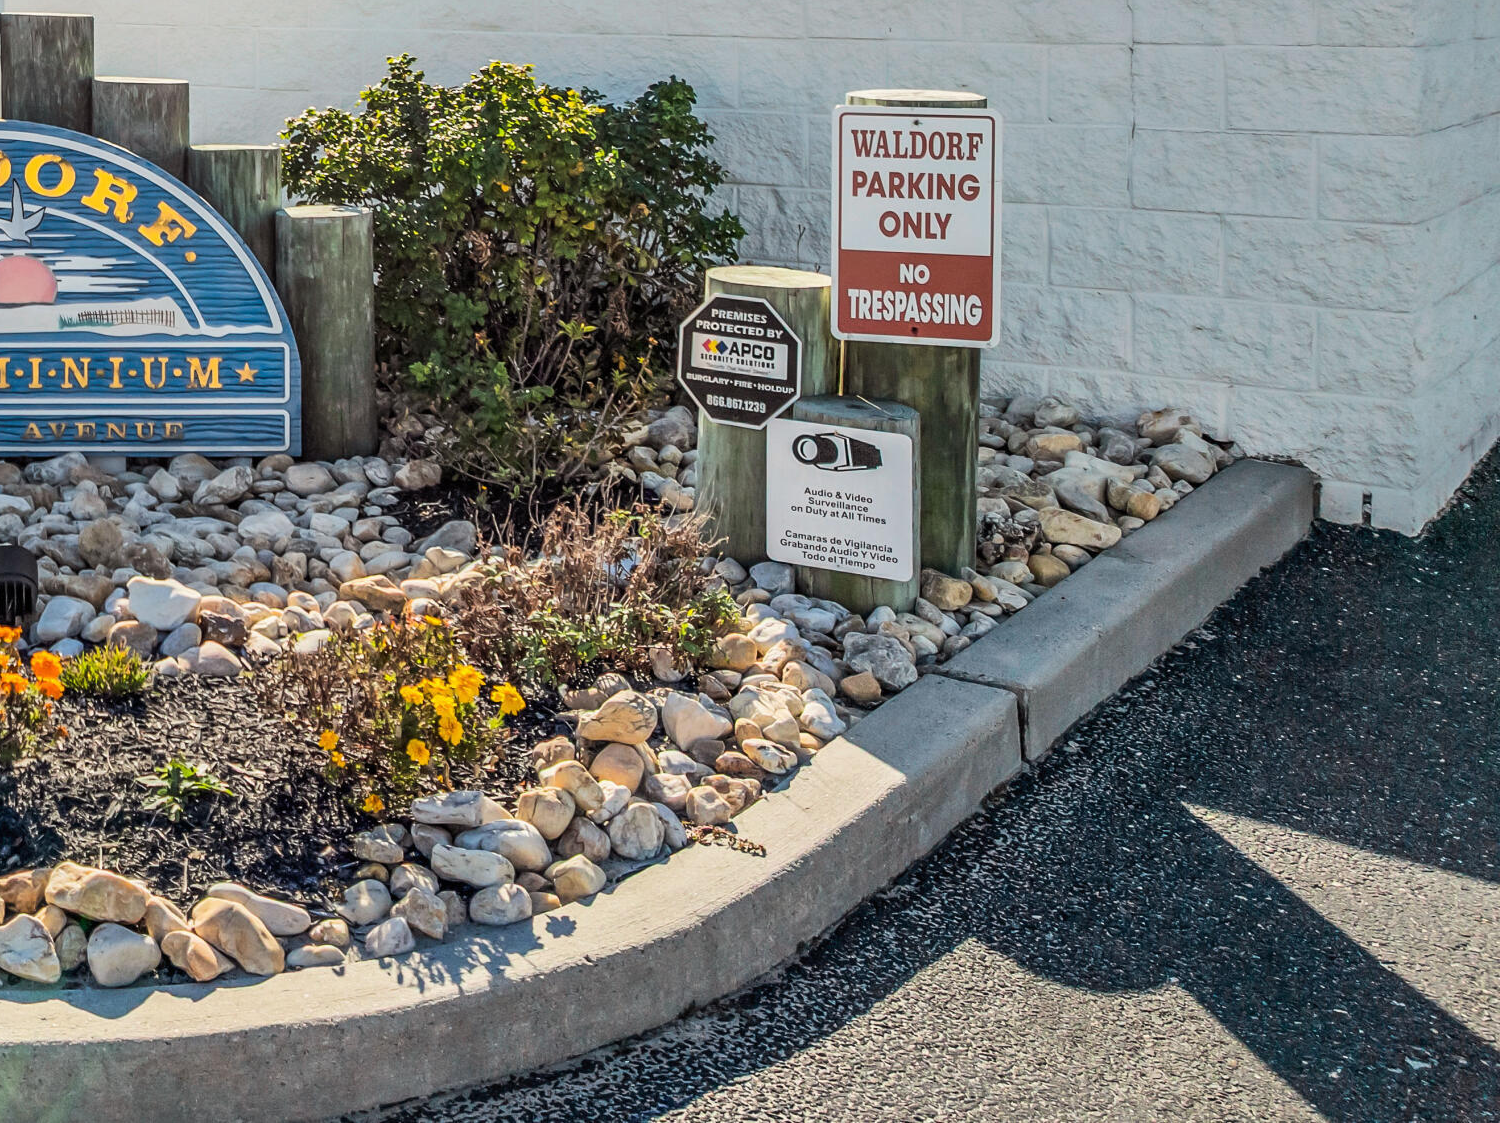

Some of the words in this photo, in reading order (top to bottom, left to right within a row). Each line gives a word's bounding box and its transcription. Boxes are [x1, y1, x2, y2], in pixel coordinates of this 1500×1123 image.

[851, 129, 983, 161] WALDORF
[851, 170, 981, 201] PARKING
[879, 210, 952, 240] ONLY
[899, 263, 930, 285] NO
[711, 308, 768, 324] PREMISES
[847, 288, 983, 326] TRESPASSING
[695, 319, 764, 337] PROTECTED
[766, 328, 784, 339] BY
[700, 352, 734, 364] SECURITY
[736, 358, 775, 370] SOLUTIONS
[729, 341, 775, 361] APCO
[686, 372, 729, 386] BURGLARY
[733, 379, 753, 389] FIRE
[757, 381, 795, 394] HOLDUP
[22, 422, 185, 440] AVENUE
[804, 487, 833, 498] Audio
[835, 491, 842, 499] &
[845, 492, 873, 504] Video
[808, 497, 869, 513] Surveillance
[805, 505, 828, 518] Duty
[830, 510, 839, 518] at
[841, 511, 854, 520] All
[857, 513, 887, 525] Times
[780, 538, 828, 553] Grabando
[829, 546, 858, 558] Audio
[860, 550, 868, 559] Y
[870, 552, 898, 564] Video
[785, 529, 828, 544] Camaras
[829, 536, 842, 546] de
[844, 538, 893, 553] Vigilancia
[802, 550, 826, 562] Todo
[828, 555, 837, 563] el
[839, 556, 876, 570] Tiempo
